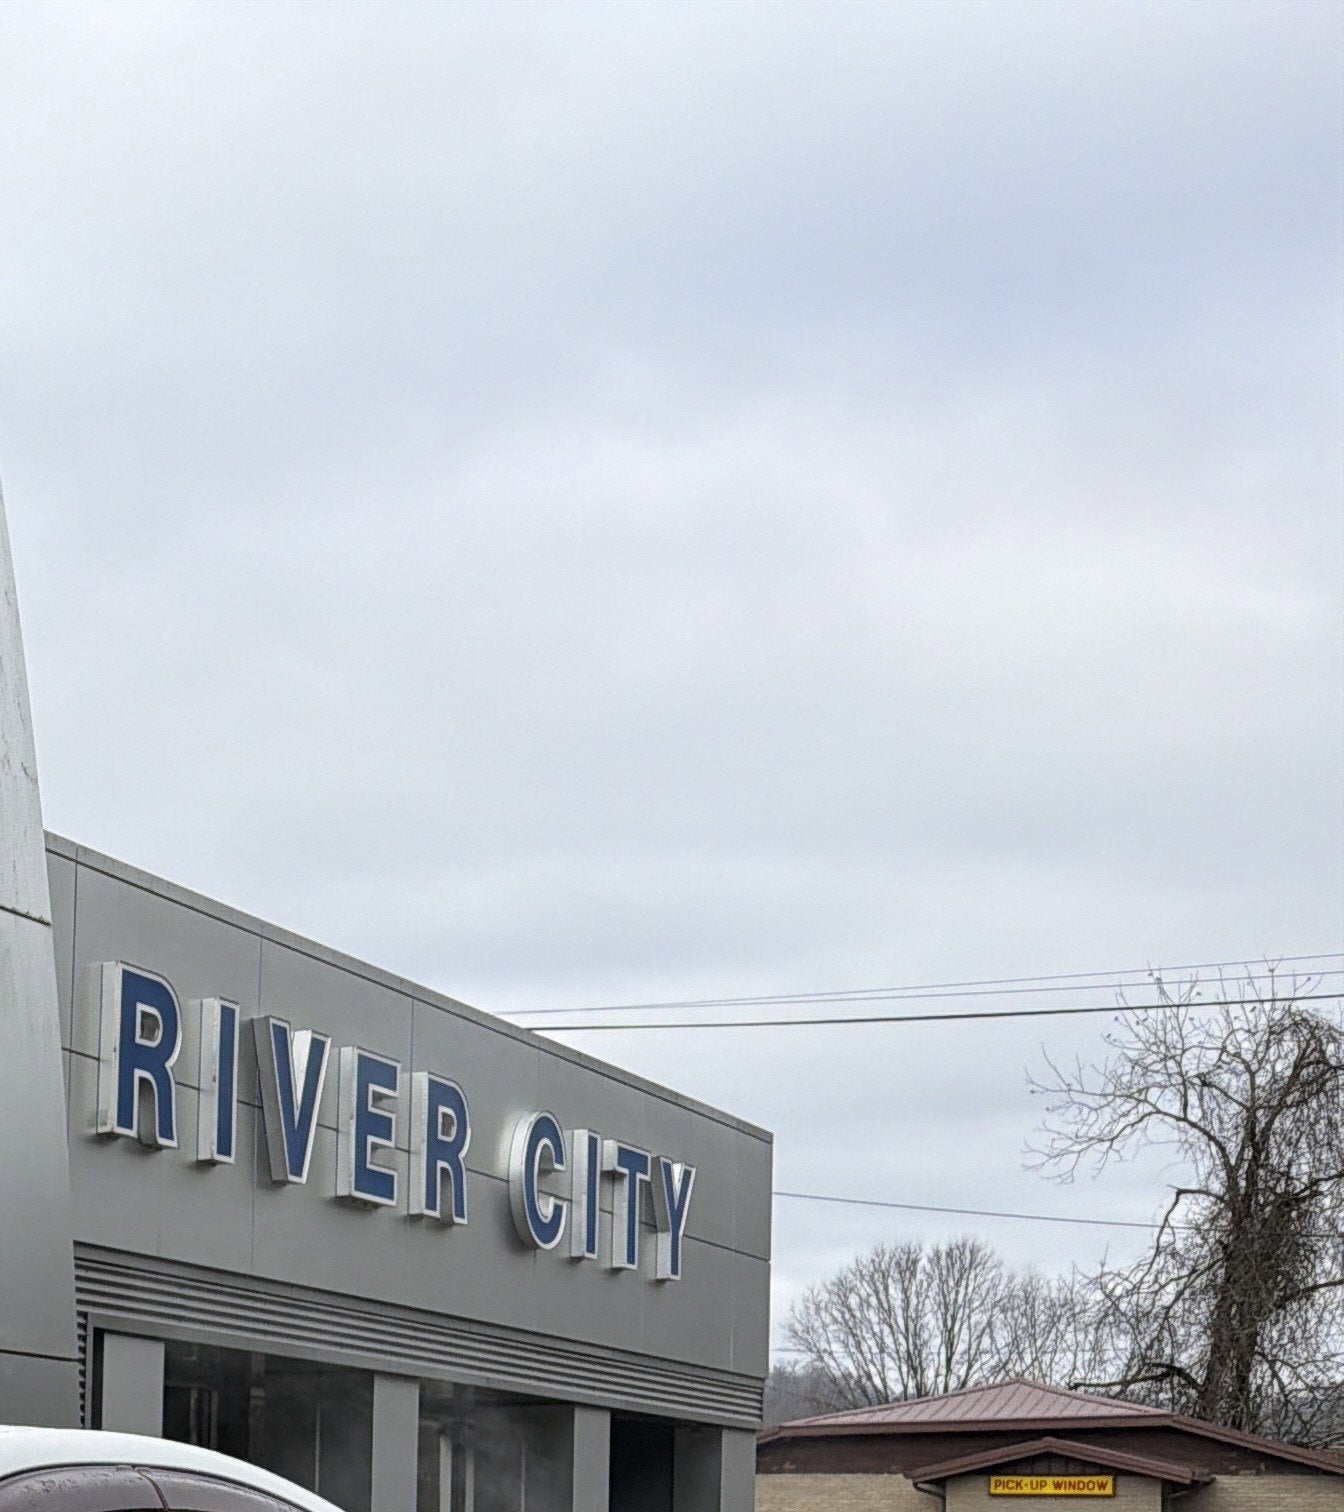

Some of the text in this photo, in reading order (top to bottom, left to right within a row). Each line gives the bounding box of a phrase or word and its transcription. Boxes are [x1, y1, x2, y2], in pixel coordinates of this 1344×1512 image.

[96, 960, 697, 1281] RIVER CITY
[993, 1478, 1109, 1491] PICK-UP WINDOW
